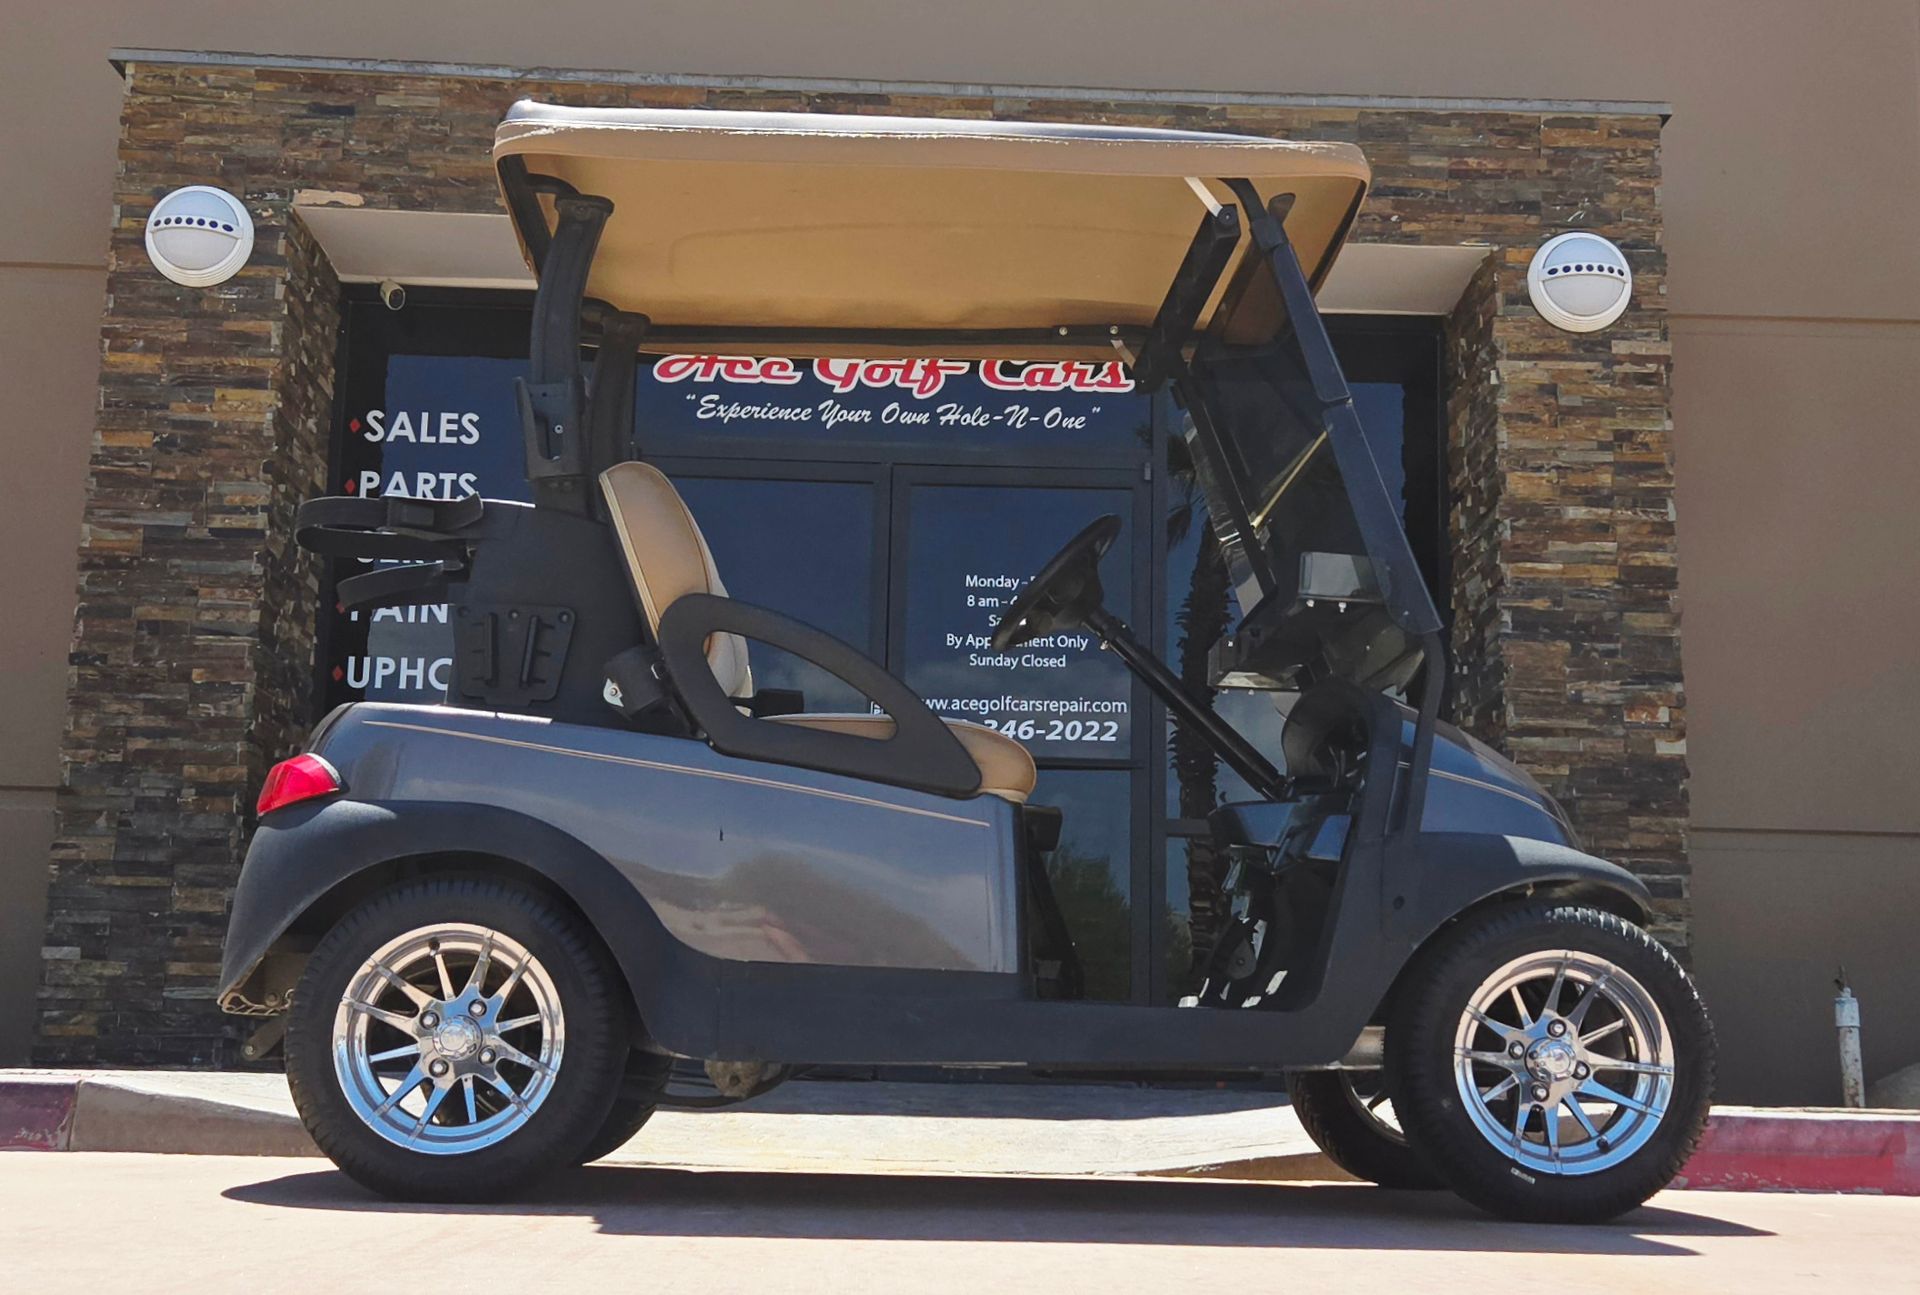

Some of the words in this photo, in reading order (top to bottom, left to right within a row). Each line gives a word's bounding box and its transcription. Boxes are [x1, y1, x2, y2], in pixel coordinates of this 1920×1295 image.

[818, 399, 872, 430] Your
[881, 402, 930, 425] Own
[363, 409, 480, 445] SALES
[358, 470, 480, 500] PARTS
[965, 574, 1020, 591] Monday
[966, 594, 976, 608] 8
[978, 597, 999, 608] am
[946, 633, 963, 649] By
[1056, 635, 1089, 651] Only
[969, 653, 1019, 671] Sunday
[1021, 654, 1066, 668] Closed
